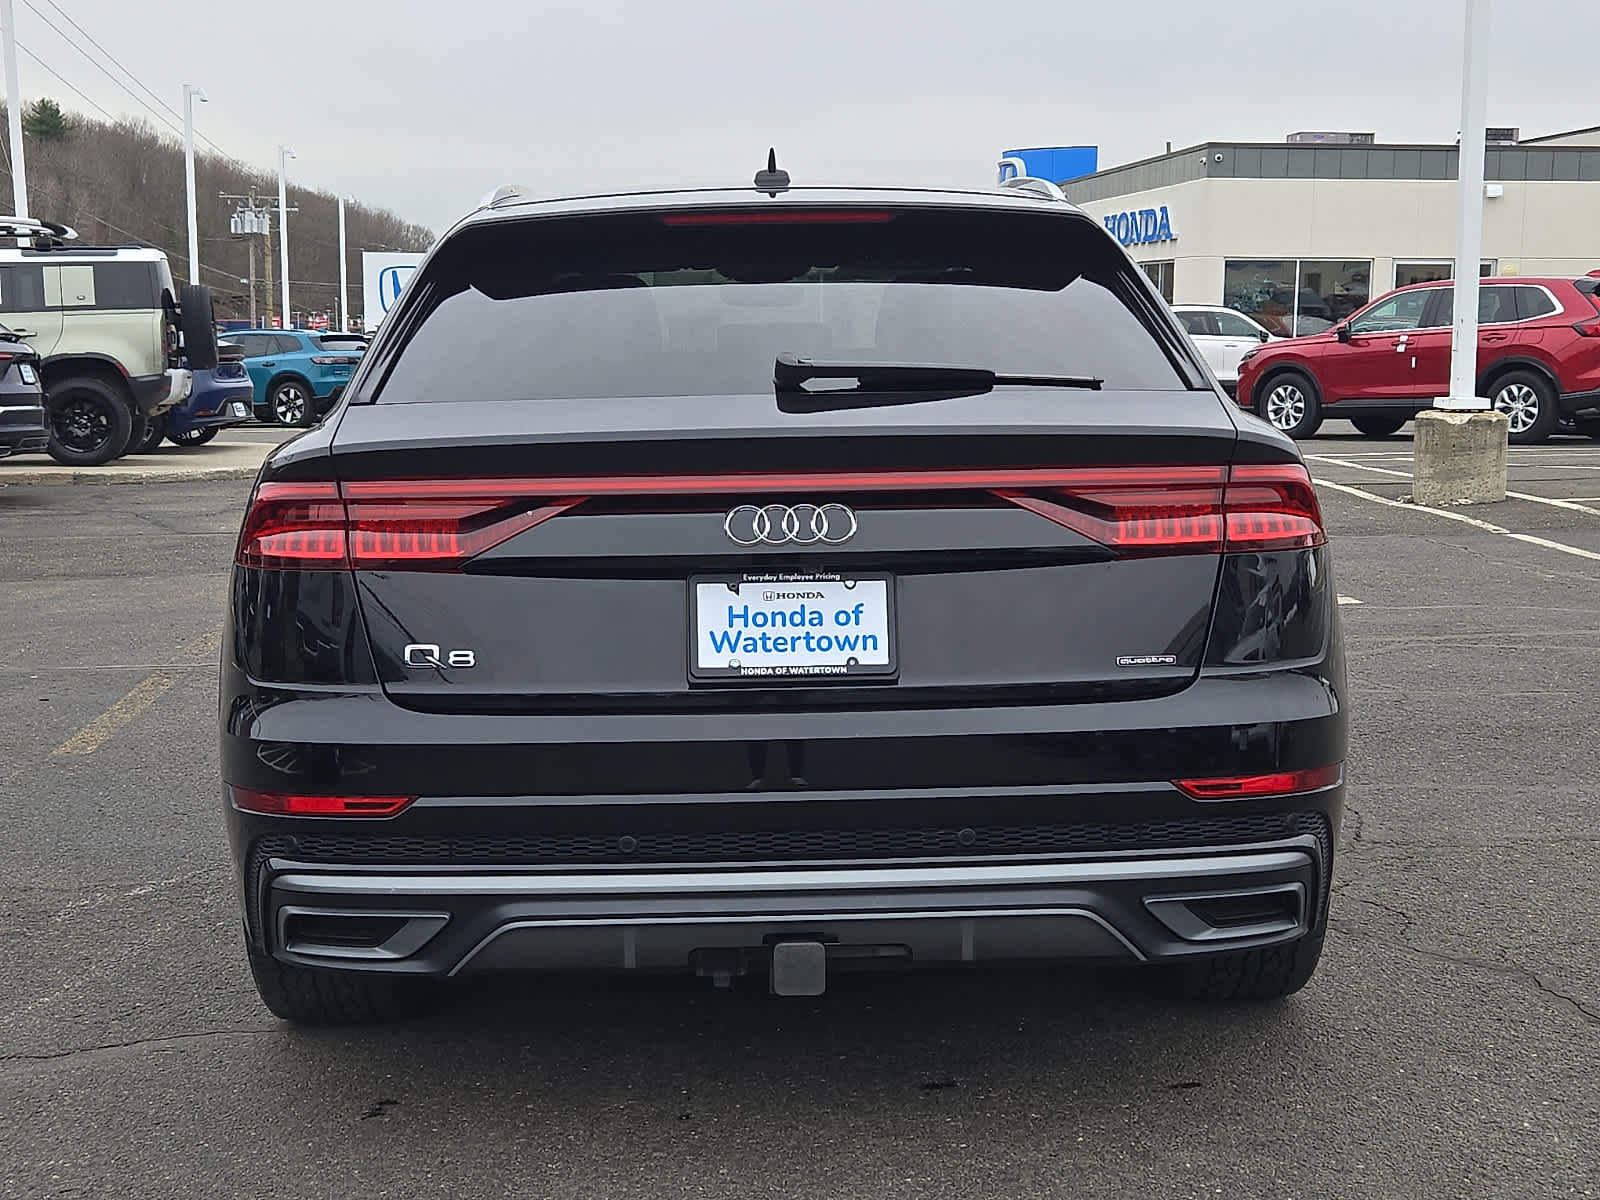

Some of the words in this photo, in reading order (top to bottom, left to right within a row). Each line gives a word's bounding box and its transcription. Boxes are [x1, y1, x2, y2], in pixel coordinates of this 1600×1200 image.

[1104, 206, 1173, 246] HONDA
[743, 573, 777, 582] Everyday
[779, 573, 814, 582] Employee
[815, 573, 841, 581] Pricing
[775, 591, 825, 600] HONDA
[728, 604, 824, 628] Honda
[834, 603, 865, 626] of
[709, 630, 878, 654] Watertown
[404, 644, 475, 669] Q8
[1120, 656, 1174, 665] quattro
[740, 667, 774, 676] HONDA
[774, 667, 789, 675] OF
[789, 666, 848, 675] WATERTOWN
